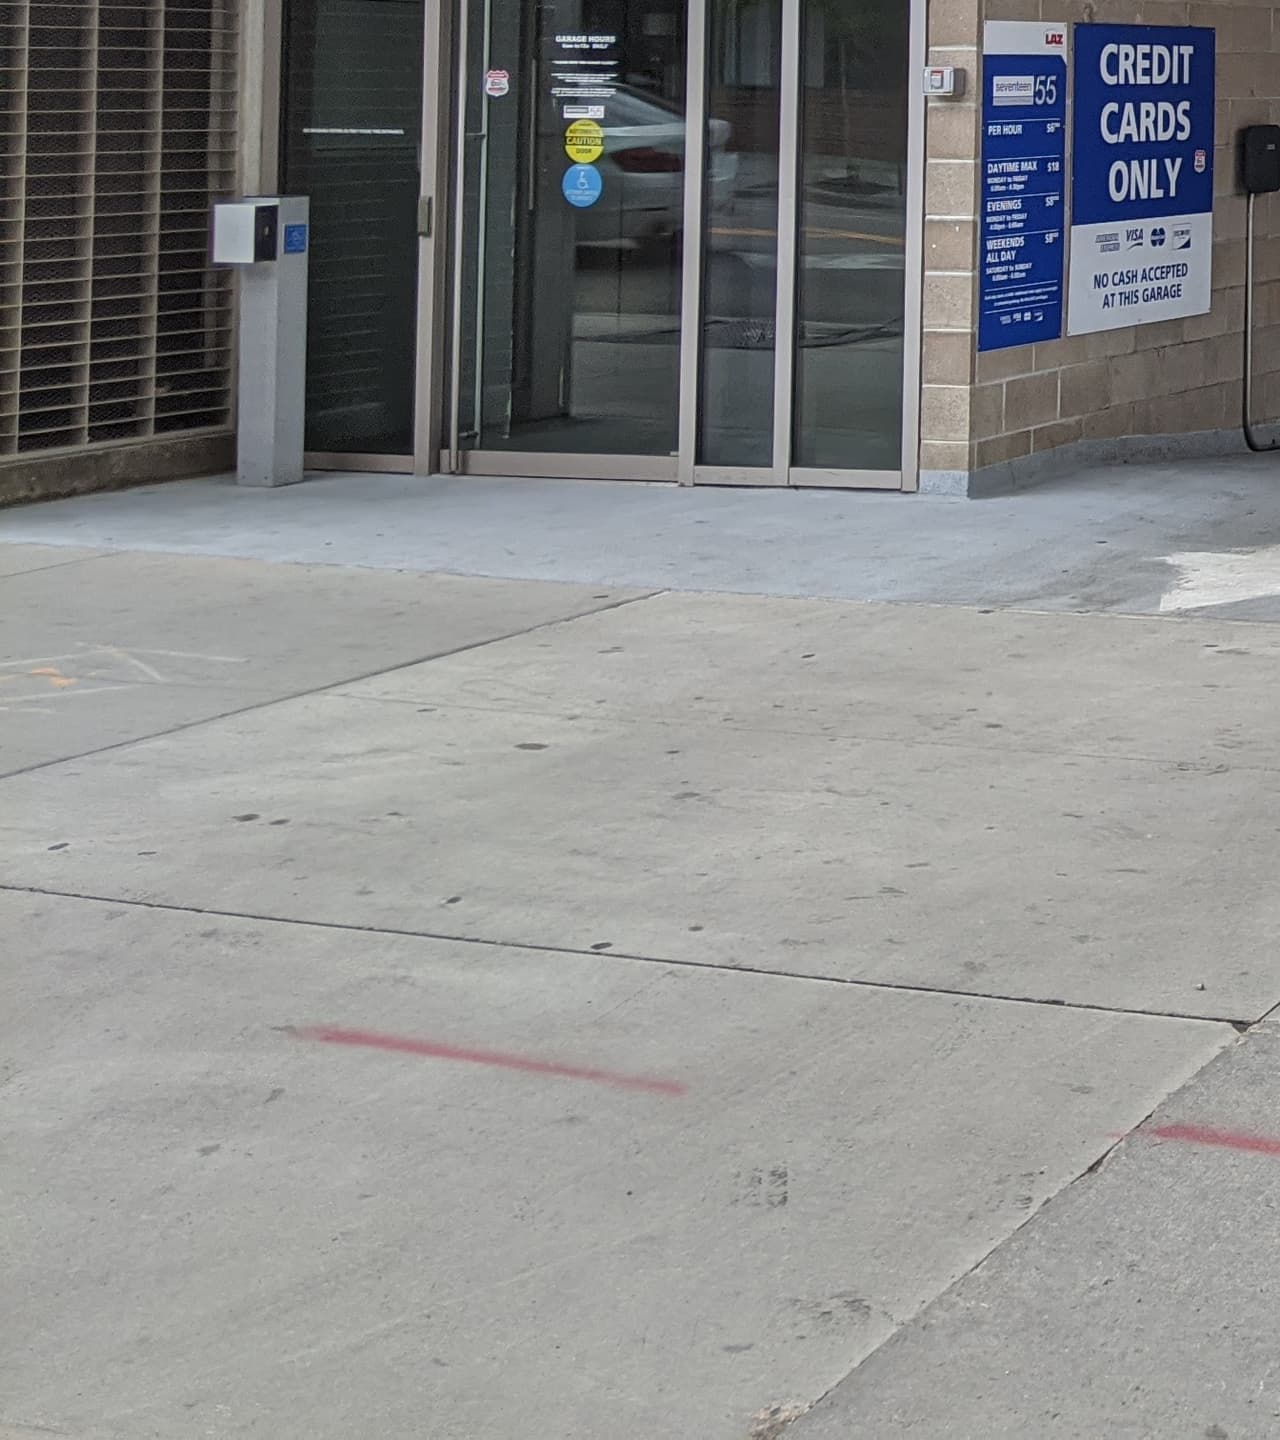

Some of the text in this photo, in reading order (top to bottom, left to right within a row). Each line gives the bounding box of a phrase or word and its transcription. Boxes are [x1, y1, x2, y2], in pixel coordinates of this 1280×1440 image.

[555, 35, 616, 43] GARAGE HOURS
[1045, 33, 1064, 45] LAZ
[1100, 43, 1194, 85] CREDIT
[1035, 75, 1057, 105] 55
[1100, 101, 1191, 144] CARDS
[988, 124, 1023, 136] PER HOUR
[566, 137, 602, 145] CAUTION
[987, 161, 1038, 174] DAYTIME MAX
[1108, 157, 1183, 202] ONLY
[987, 199, 1022, 212] EVENINGS
[1126, 228, 1144, 242] VISA
[986, 236, 1025, 250] WEEKENDS
[986, 250, 1017, 263] ALL DAY
[1093, 263, 1188, 289] NO CASH ACCEPTED
[1102, 284, 1182, 309] AT THIS GARAGE
